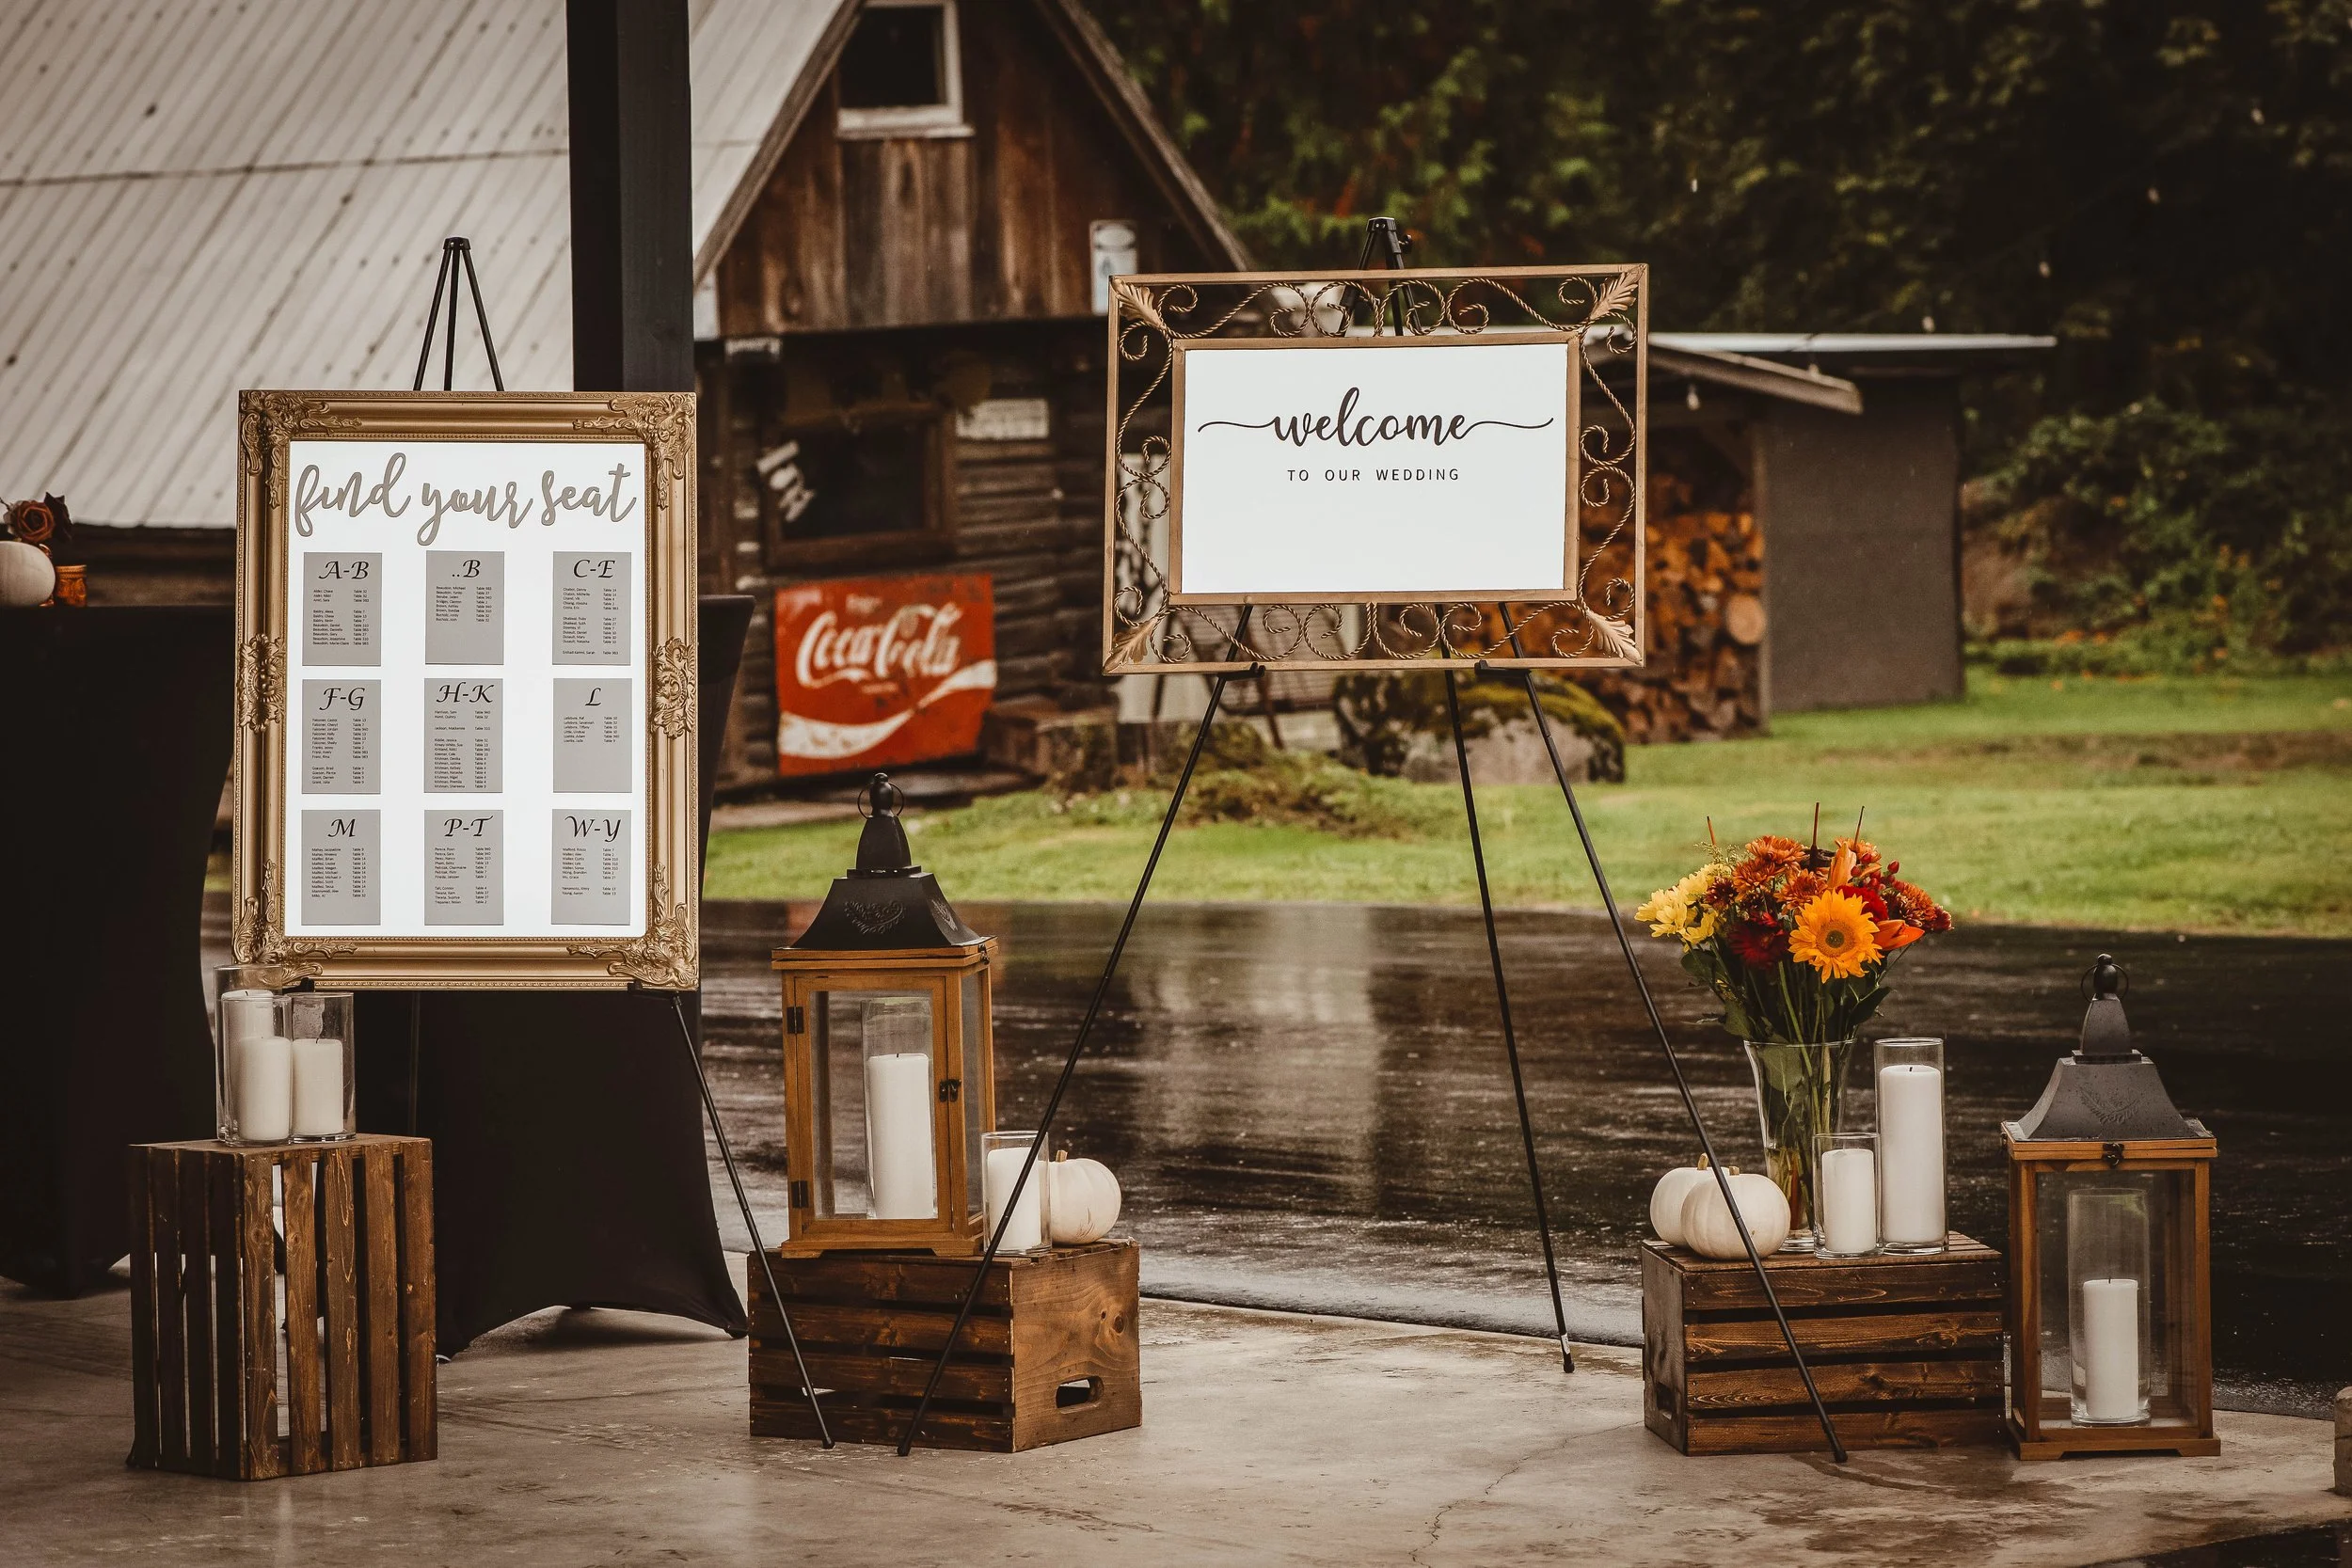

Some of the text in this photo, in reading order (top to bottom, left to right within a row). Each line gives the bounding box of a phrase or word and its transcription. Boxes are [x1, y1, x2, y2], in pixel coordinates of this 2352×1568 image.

[1198, 388, 1553, 447] welcome
[1287, 467, 1459, 483] TO OUR WEDDING
[294, 452, 637, 546] find your seat
[318, 561, 370, 580] A-B
[452, 559, 481, 578] ..B
[573, 559, 616, 578] C-E
[318, 687, 366, 711] F-G
[436, 681, 495, 704] H-K
[584, 687, 602, 706] L
[327, 818, 356, 838] M
[443, 815, 494, 837] P-T
[564, 816, 621, 843] W-Y
